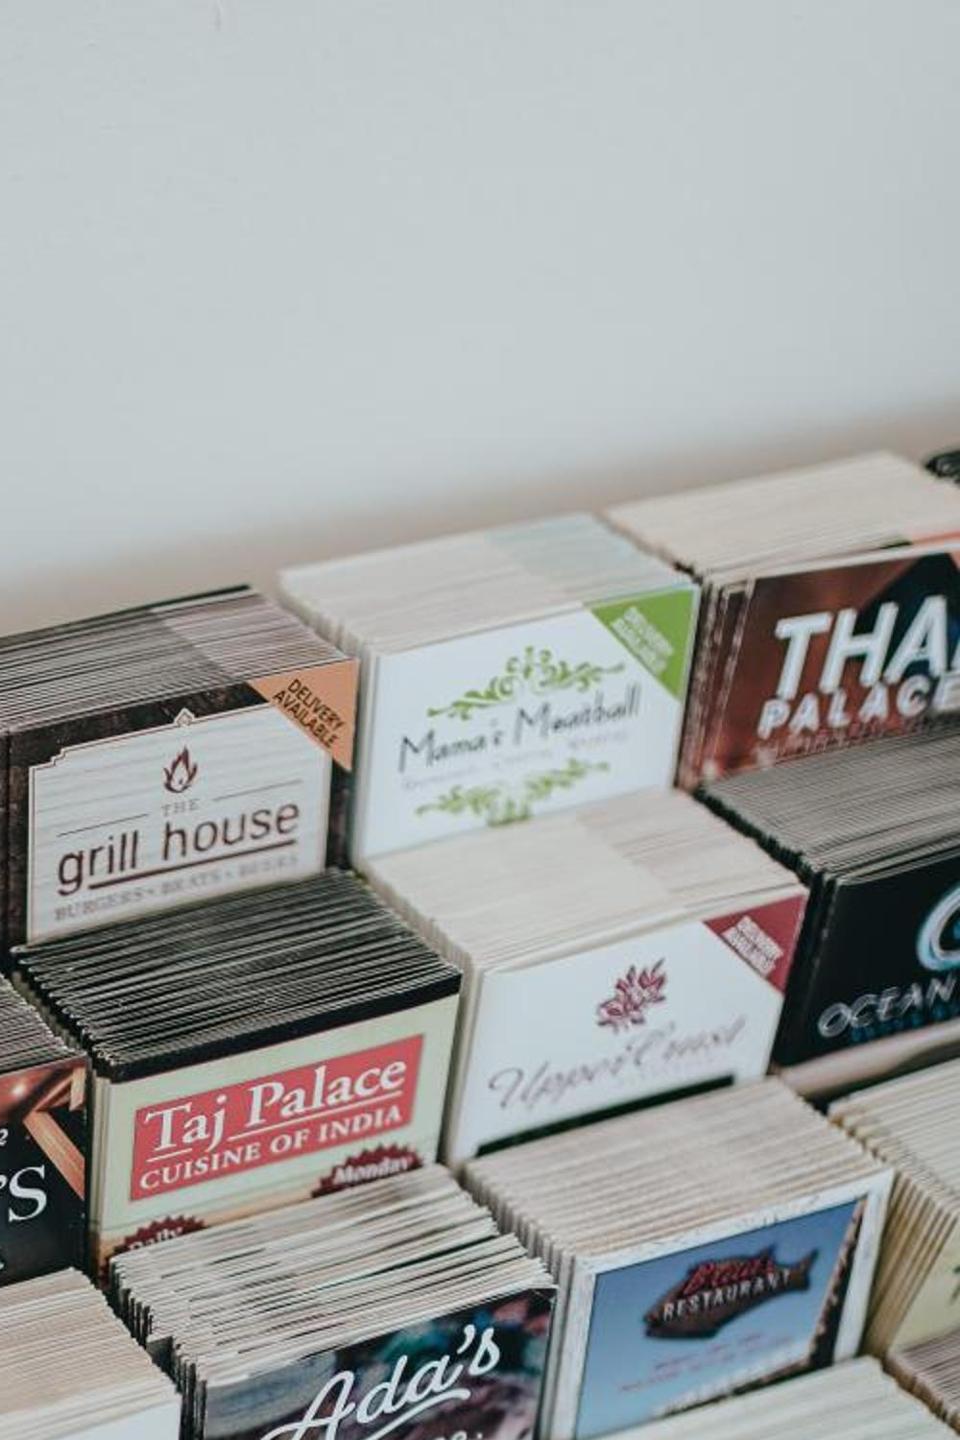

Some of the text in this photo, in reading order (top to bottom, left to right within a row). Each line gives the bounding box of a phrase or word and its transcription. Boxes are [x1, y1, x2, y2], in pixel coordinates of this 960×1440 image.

[775, 595, 959, 701] THA
[273, 690, 338, 748] AVAILABLE
[287, 679, 345, 730] DELIVERY
[161, 798, 200, 817] THE
[58, 804, 300, 896] grill house
[818, 972, 958, 1037] OCEAN
[145, 1060, 407, 1152] Taj Palace
[140, 1105, 402, 1191] CUISINE OF INDIA
[663, 1269, 792, 1322] RESTAURANT
